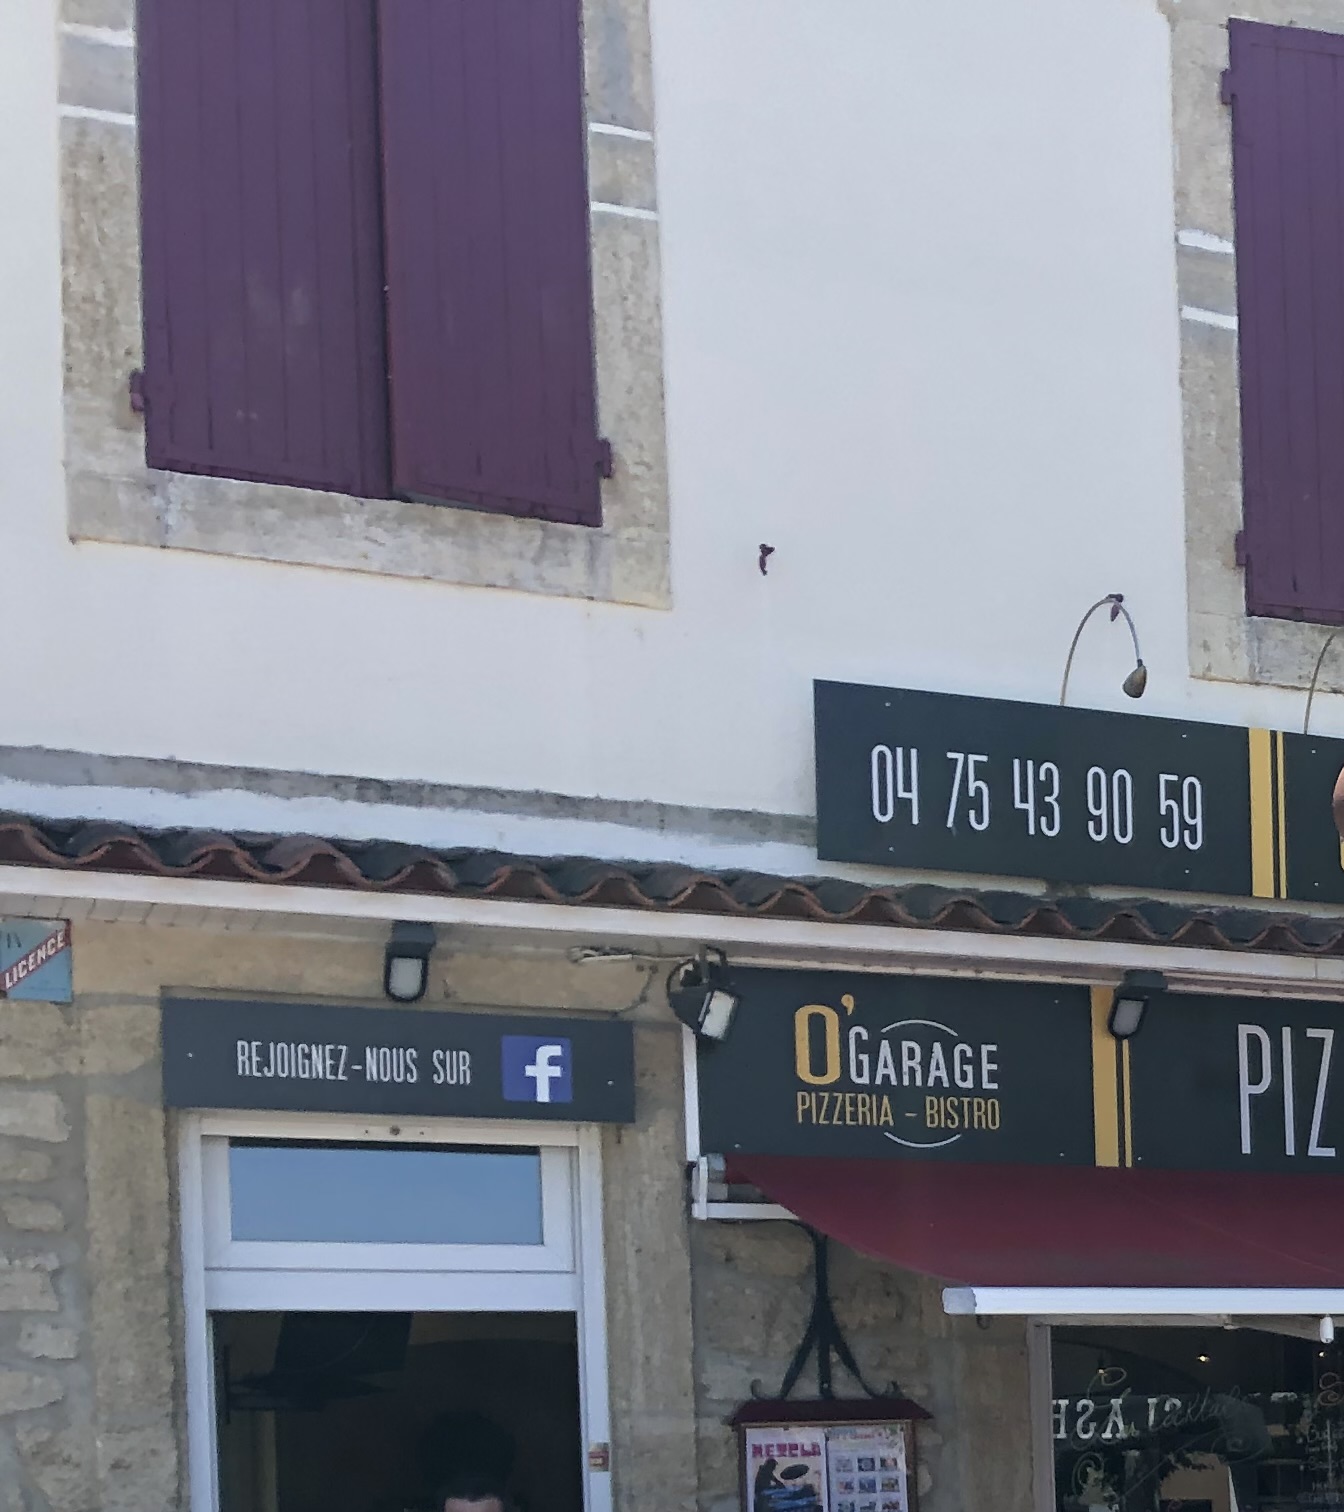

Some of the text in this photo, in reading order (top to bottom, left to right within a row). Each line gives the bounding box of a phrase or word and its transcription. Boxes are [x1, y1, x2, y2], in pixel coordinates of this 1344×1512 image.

[871, 744, 1203, 851] 04 75 43 90 59
[4, 930, 66, 990] LICENCE
[432, 1050, 472, 1086] SUR
[794, 994, 999, 1090] O'GARAGE
[797, 1091, 894, 1127] PIZZERIA
[925, 1095, 1000, 1130] BISTRO
